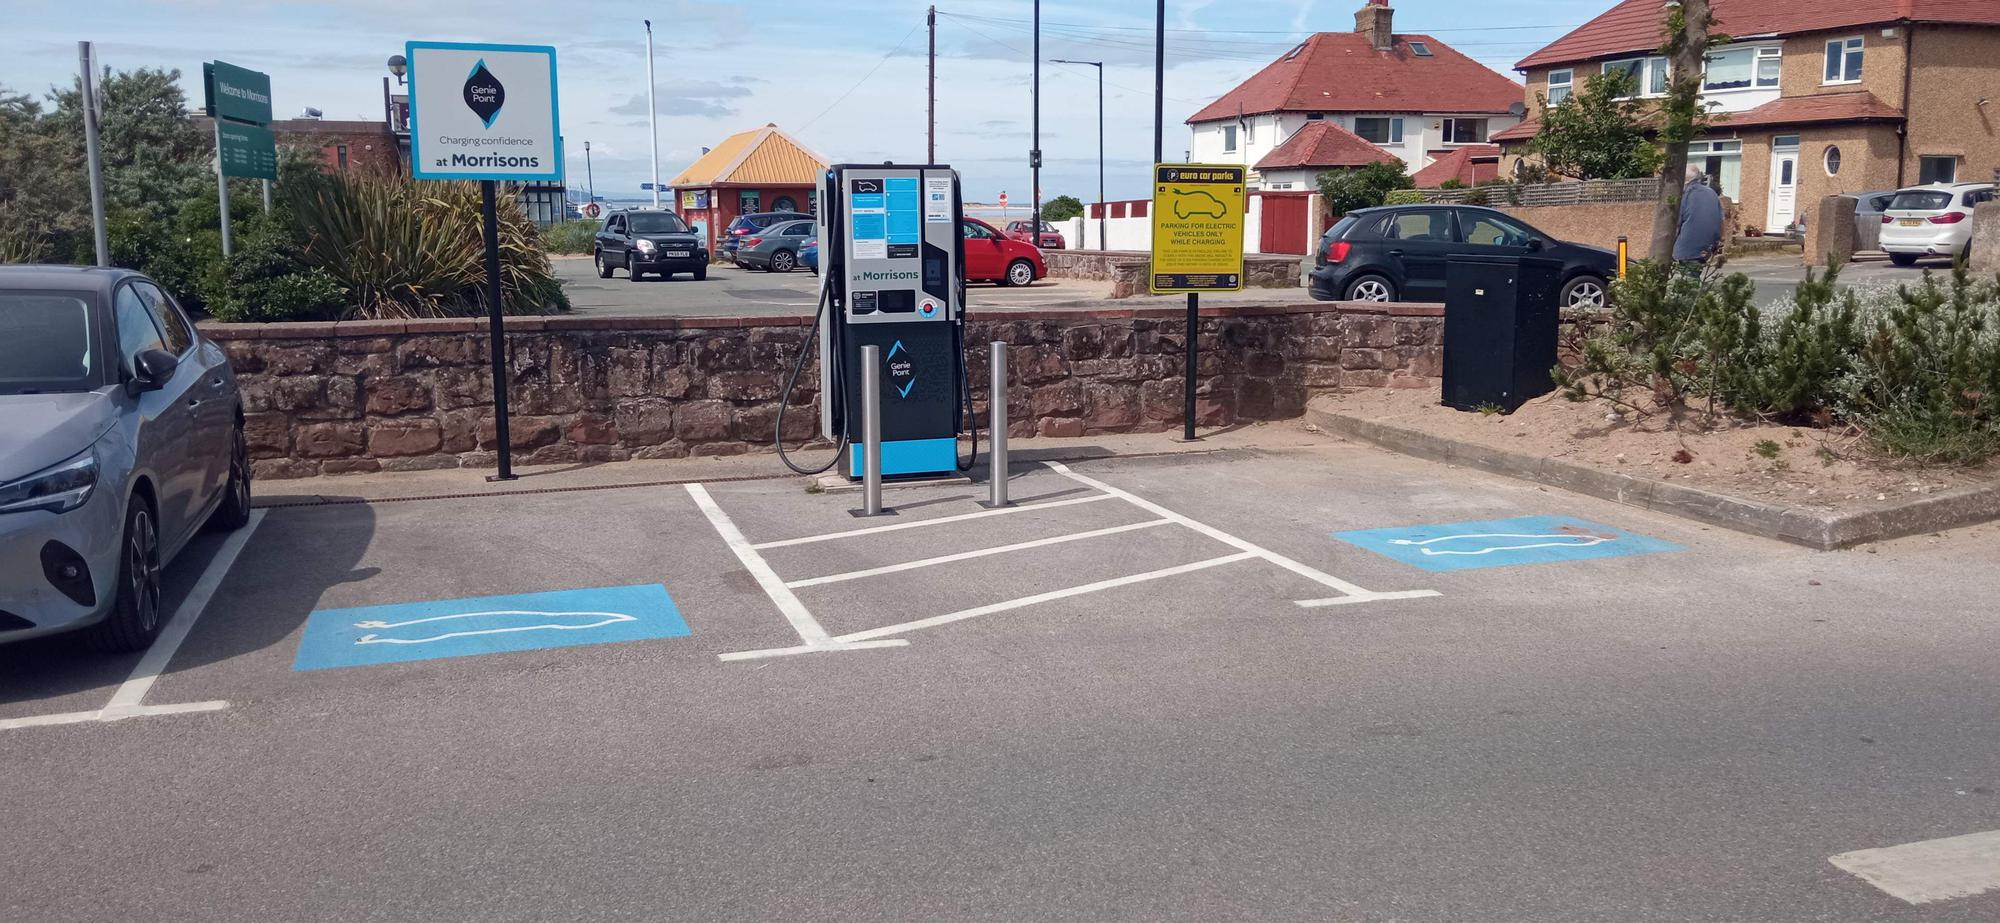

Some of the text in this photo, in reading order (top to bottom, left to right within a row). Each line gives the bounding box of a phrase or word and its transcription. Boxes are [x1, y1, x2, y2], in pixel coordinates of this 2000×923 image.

[219, 82, 268, 104] Welcome to Morrisons
[471, 85, 496, 94] Genie
[439, 136, 533, 146] Charging confidence
[436, 152, 539, 168] at Morrisons
[1180, 172, 1198, 180] euro
[1199, 172, 1210, 180] car
[1212, 171, 1233, 181] parks
[863, 269, 919, 281] Morrisons
[890, 361, 911, 370] Genie
[892, 369, 910, 377] Point
